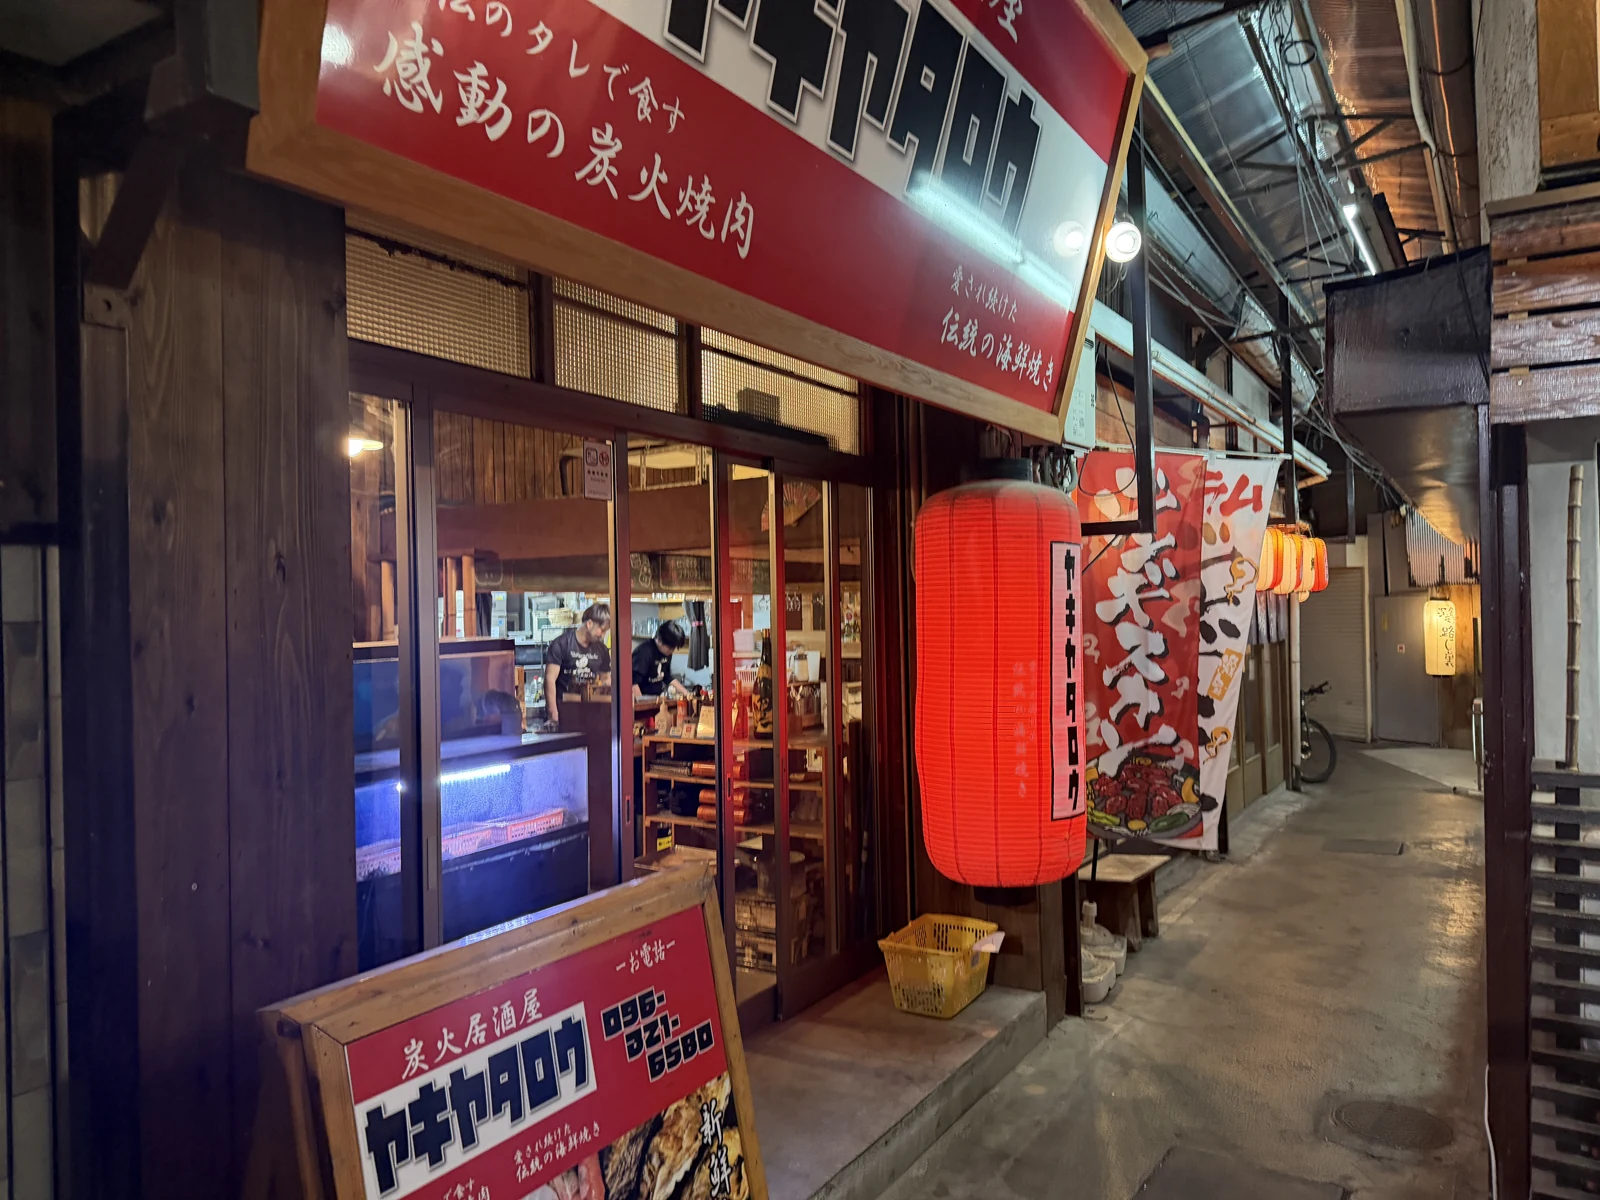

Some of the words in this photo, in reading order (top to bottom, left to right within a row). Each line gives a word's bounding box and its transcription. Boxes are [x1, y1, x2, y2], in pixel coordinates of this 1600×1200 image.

[374, 21, 754, 259] 感動の炭火焼肉
[951, 264, 1017, 323] 愛され続けた
[941, 306, 1054, 392] 伝統の海鮮焼き
[1064, 549, 1079, 811] ヤキヤタロウ
[402, 987, 543, 1080] 炭火居酒屋
[646, 1018, 715, 1083] 6580
[364, 1013, 588, 1198] ヤキヤタロウ
[516, 1120, 600, 1183] 伝統の海鮮焼き
[699, 1098, 733, 1200] 新鮮
